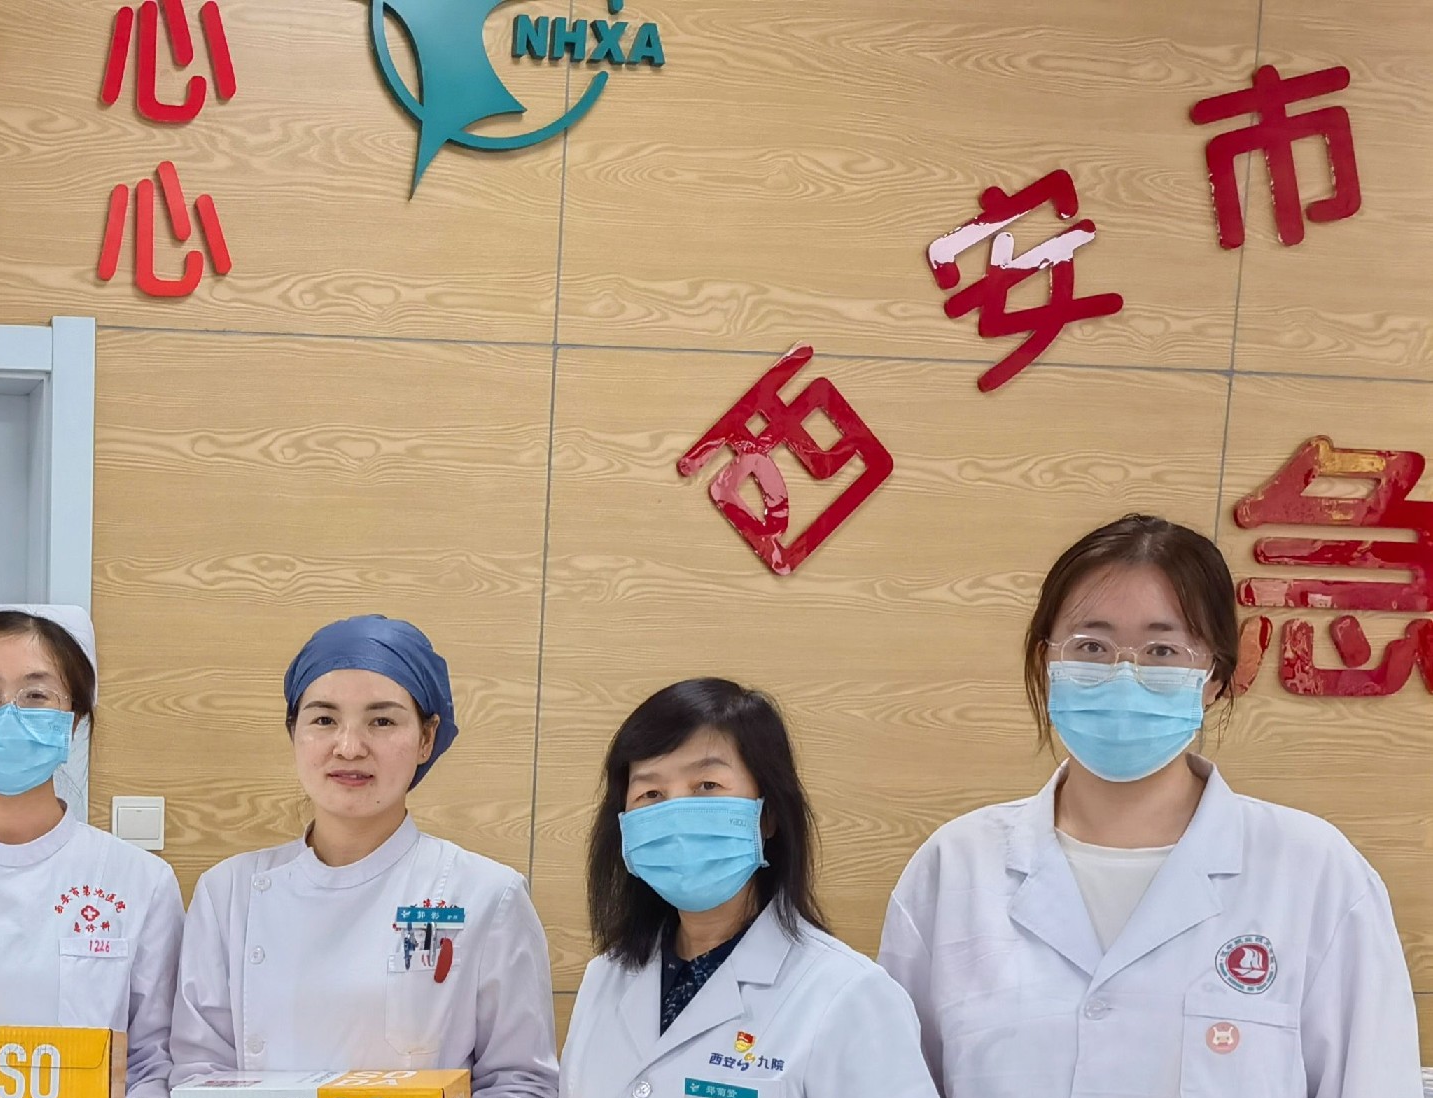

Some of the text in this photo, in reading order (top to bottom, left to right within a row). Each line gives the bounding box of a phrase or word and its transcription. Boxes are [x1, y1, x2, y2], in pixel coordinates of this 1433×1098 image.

[510, 15, 667, 67] NHXA
[678, 63, 1362, 576] 西安市
[1234, 435, 1433, 696] 急
[708, 1052, 785, 1071] 西安 九院
